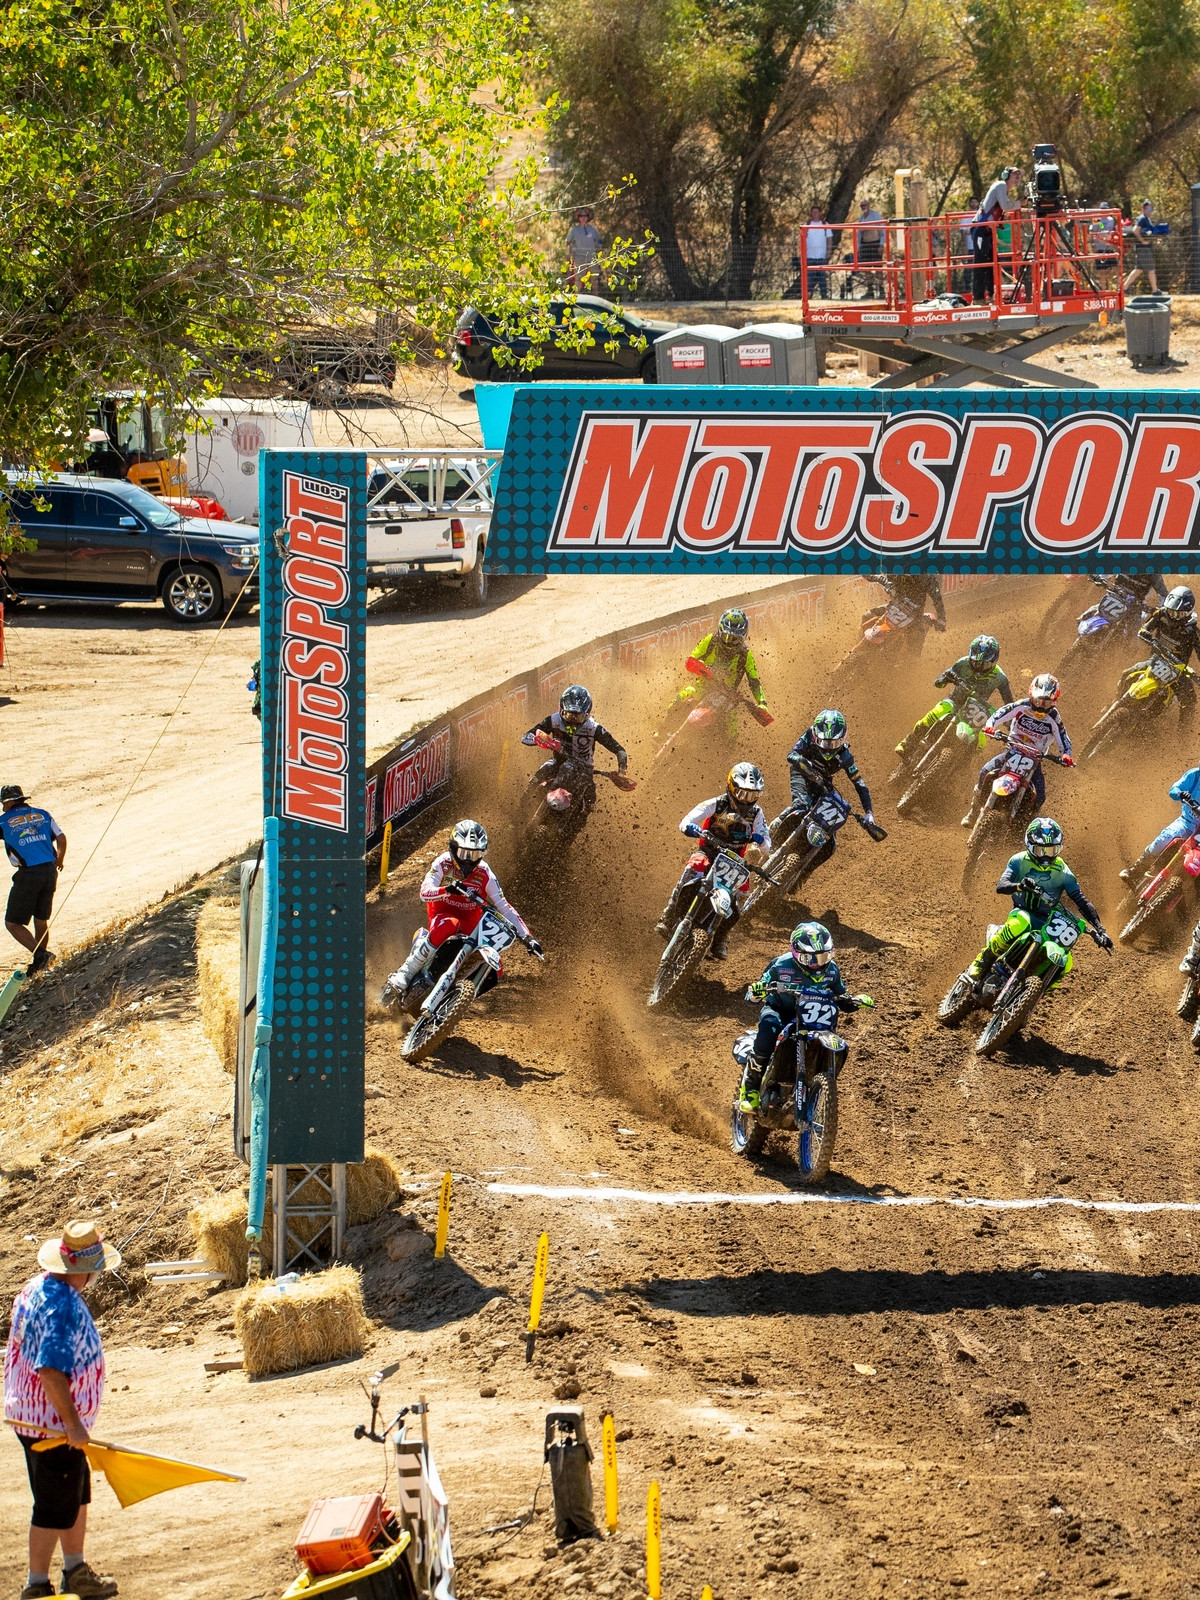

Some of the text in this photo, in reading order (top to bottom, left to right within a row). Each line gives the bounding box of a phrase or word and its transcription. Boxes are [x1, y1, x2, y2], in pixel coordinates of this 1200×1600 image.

[811, 312, 844, 323] SKYJACK
[914, 312, 947, 323] SKYJACK
[302, 480, 346, 499] .com
[966, 703, 988, 727] 30
[1006, 753, 1035, 774] 42
[816, 800, 845, 826] 147
[25, 834, 47, 844] YAMAHA
[715, 861, 748, 888] 241
[482, 920, 513, 950] 24
[1045, 918, 1078, 947] 38
[801, 1002, 837, 1026] 32
